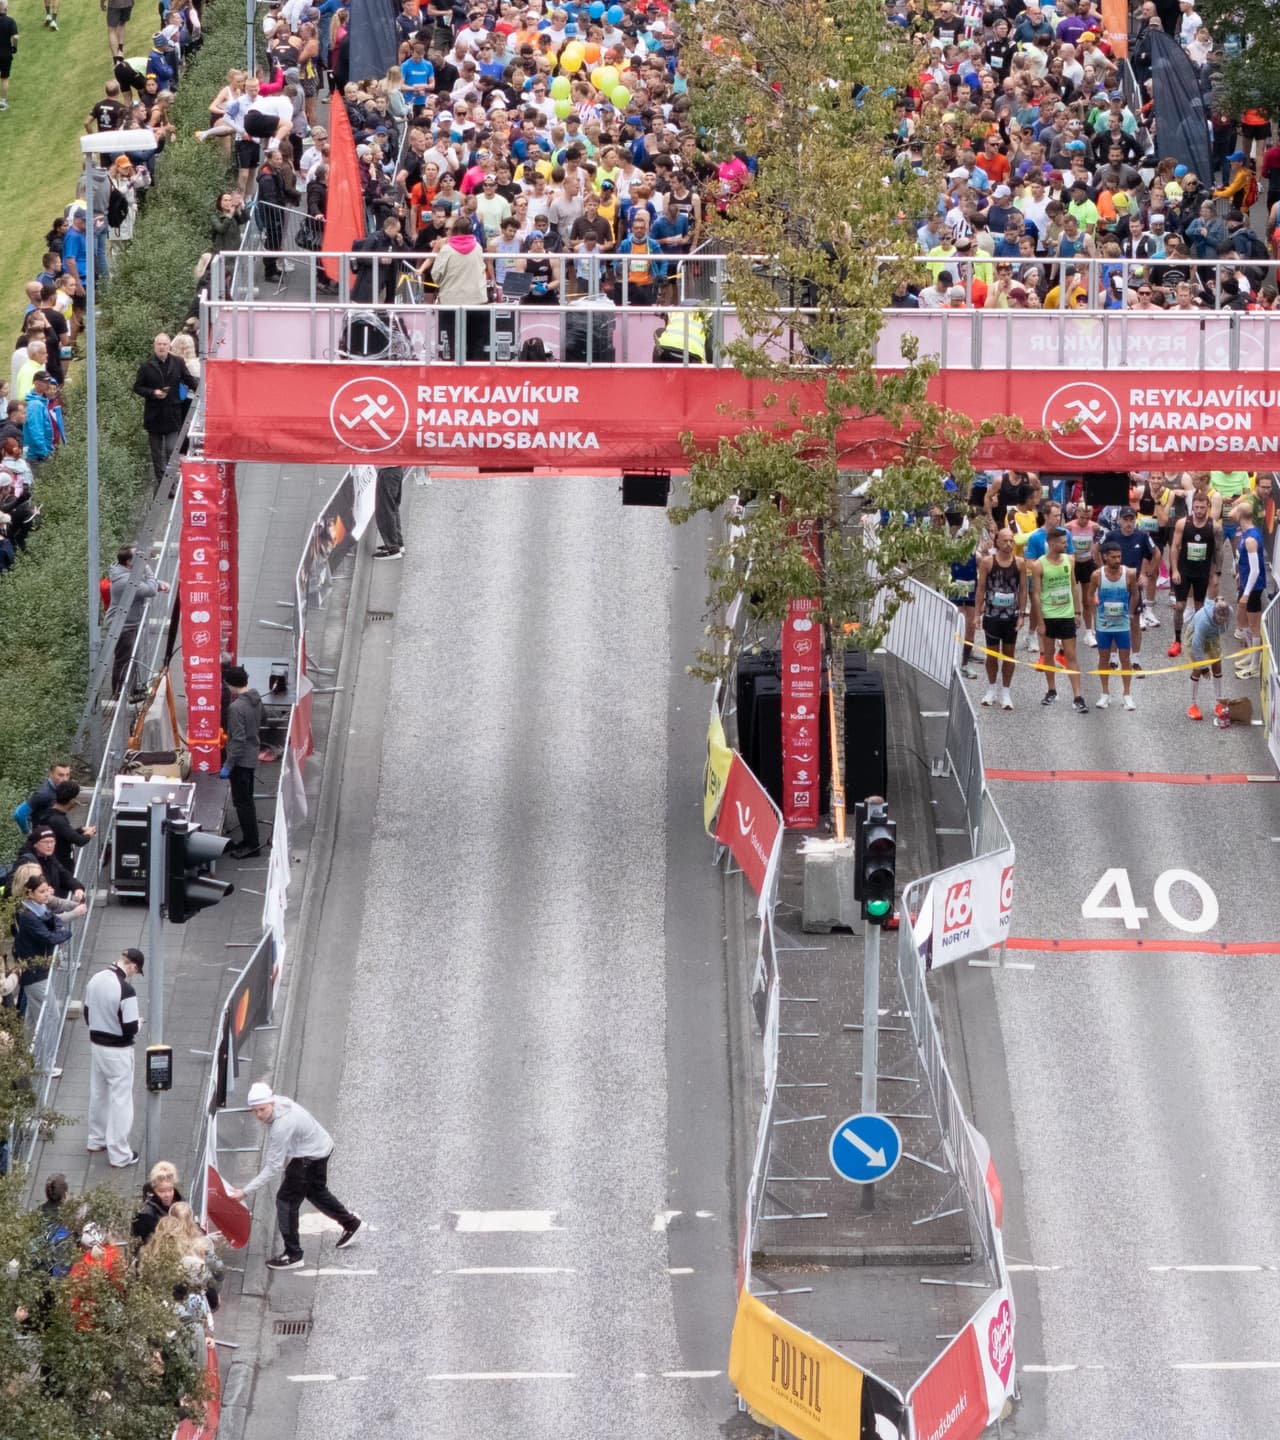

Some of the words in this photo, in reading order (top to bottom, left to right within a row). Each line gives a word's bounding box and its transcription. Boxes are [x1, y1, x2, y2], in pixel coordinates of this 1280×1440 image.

[417, 382, 579, 403] REYKJAVÍKUR
[416, 408, 539, 426] MARAÞON
[1129, 412, 1252, 430] MARAÞON
[416, 426, 600, 449] ÍSLANDSBANKA
[1080, 867, 1220, 934] 40
[942, 928, 970, 948] NORTH
[771, 1333, 821, 1413] FULFIL
